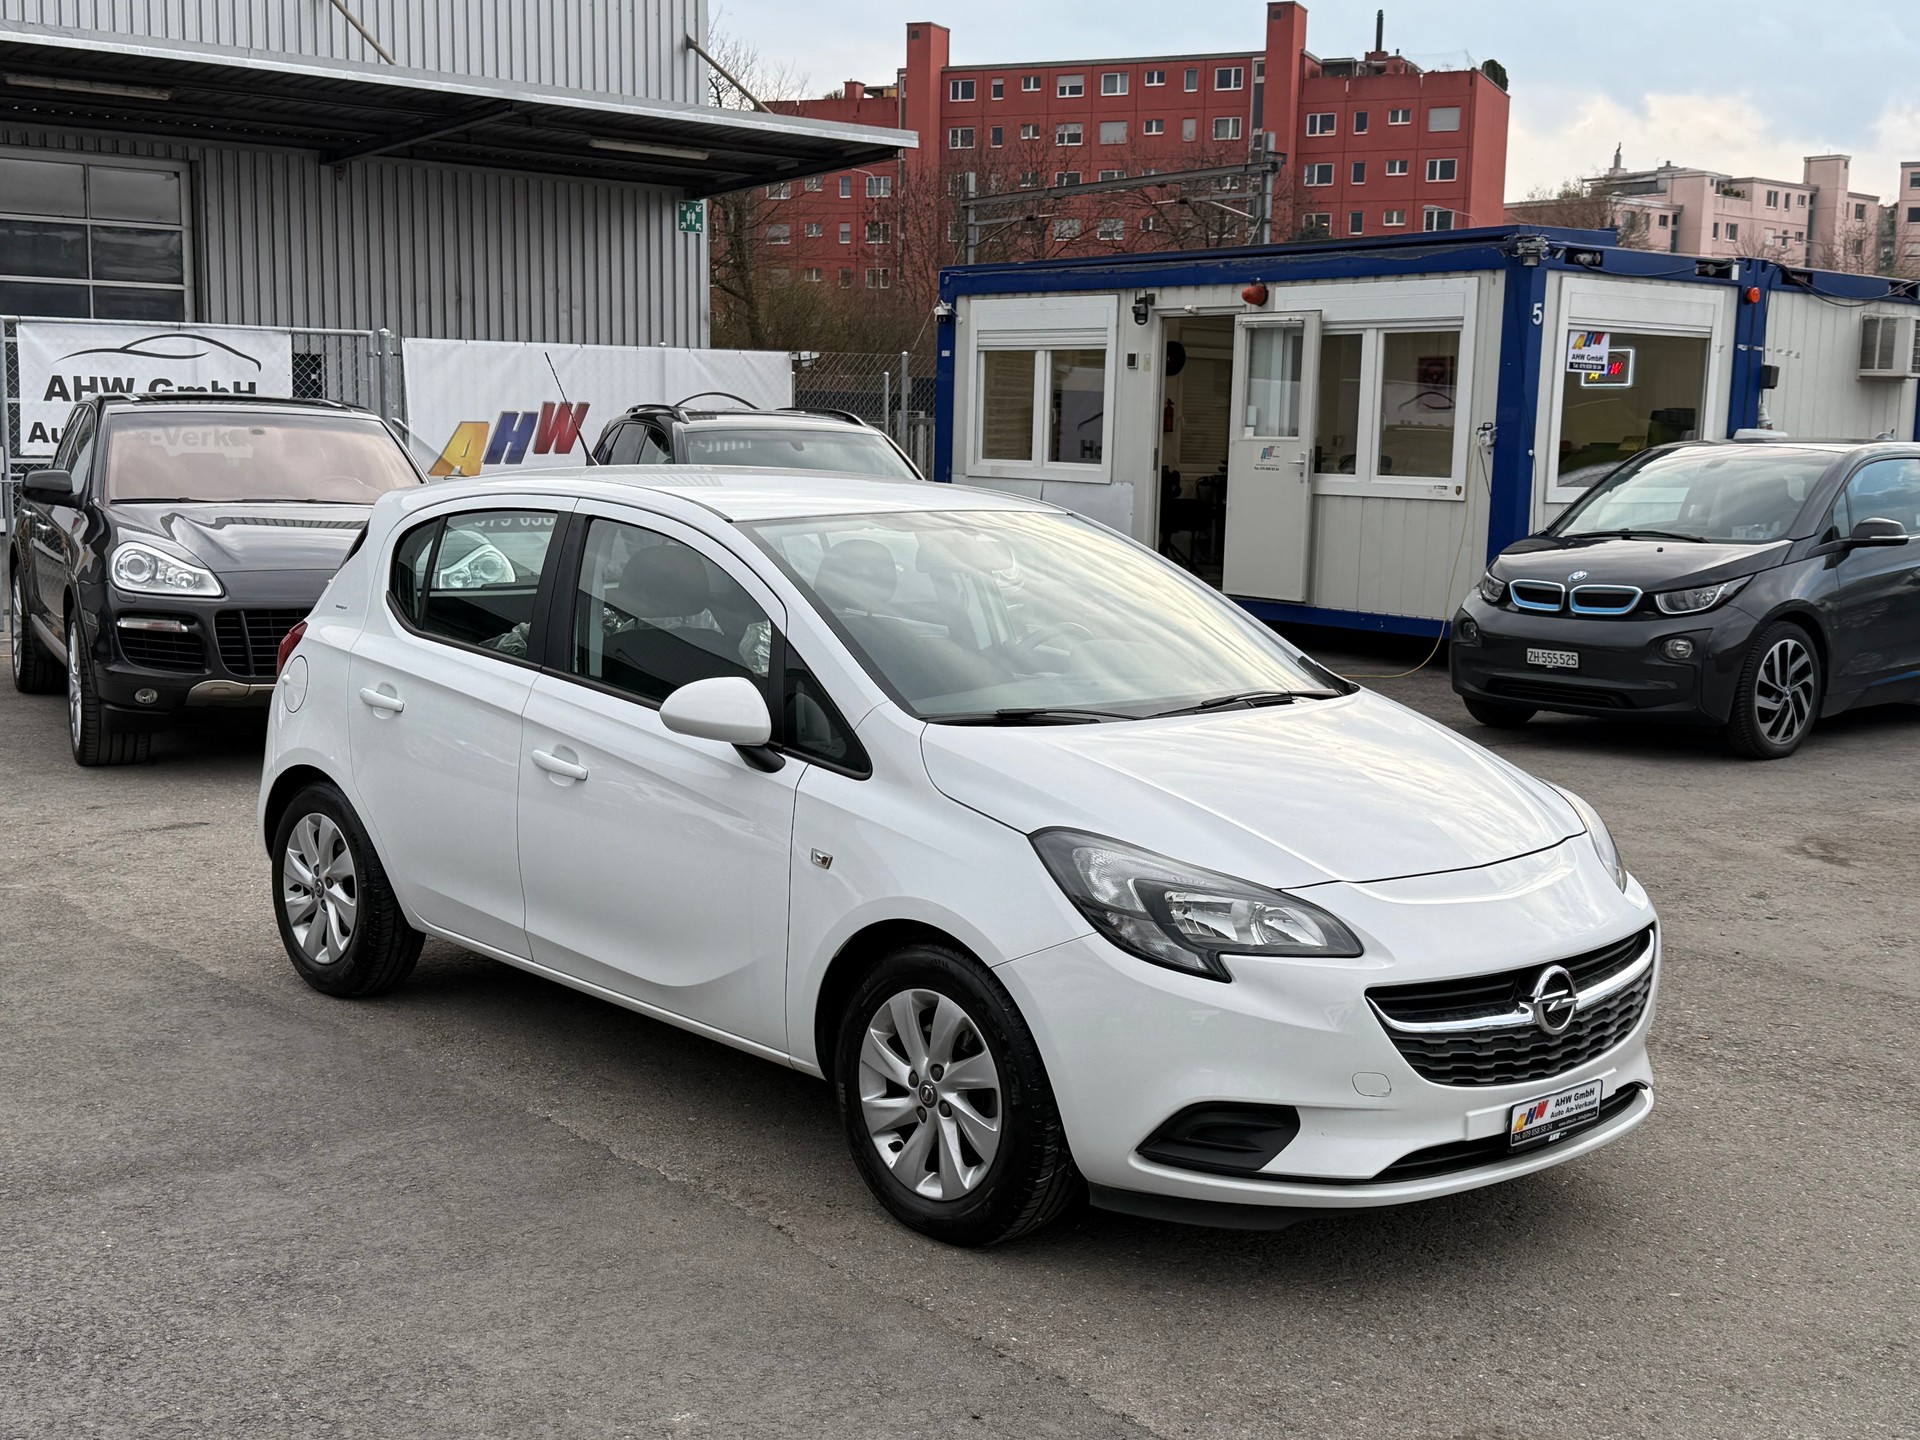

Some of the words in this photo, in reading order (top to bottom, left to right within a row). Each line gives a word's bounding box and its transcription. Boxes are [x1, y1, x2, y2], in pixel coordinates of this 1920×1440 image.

[1532, 302, 1543, 326] 5
[1571, 331, 1605, 350] AHW
[1571, 353, 1586, 361] AHW
[1586, 354, 1604, 362] GmbH
[43, 375, 135, 402] AHW
[427, 401, 591, 477] AHW
[1555, 1094, 1573, 1108] AHW
[1573, 1087, 1595, 1102] GmbH
[1512, 1099, 1550, 1133] AHW
[1550, 1109, 1565, 1119] Auto
